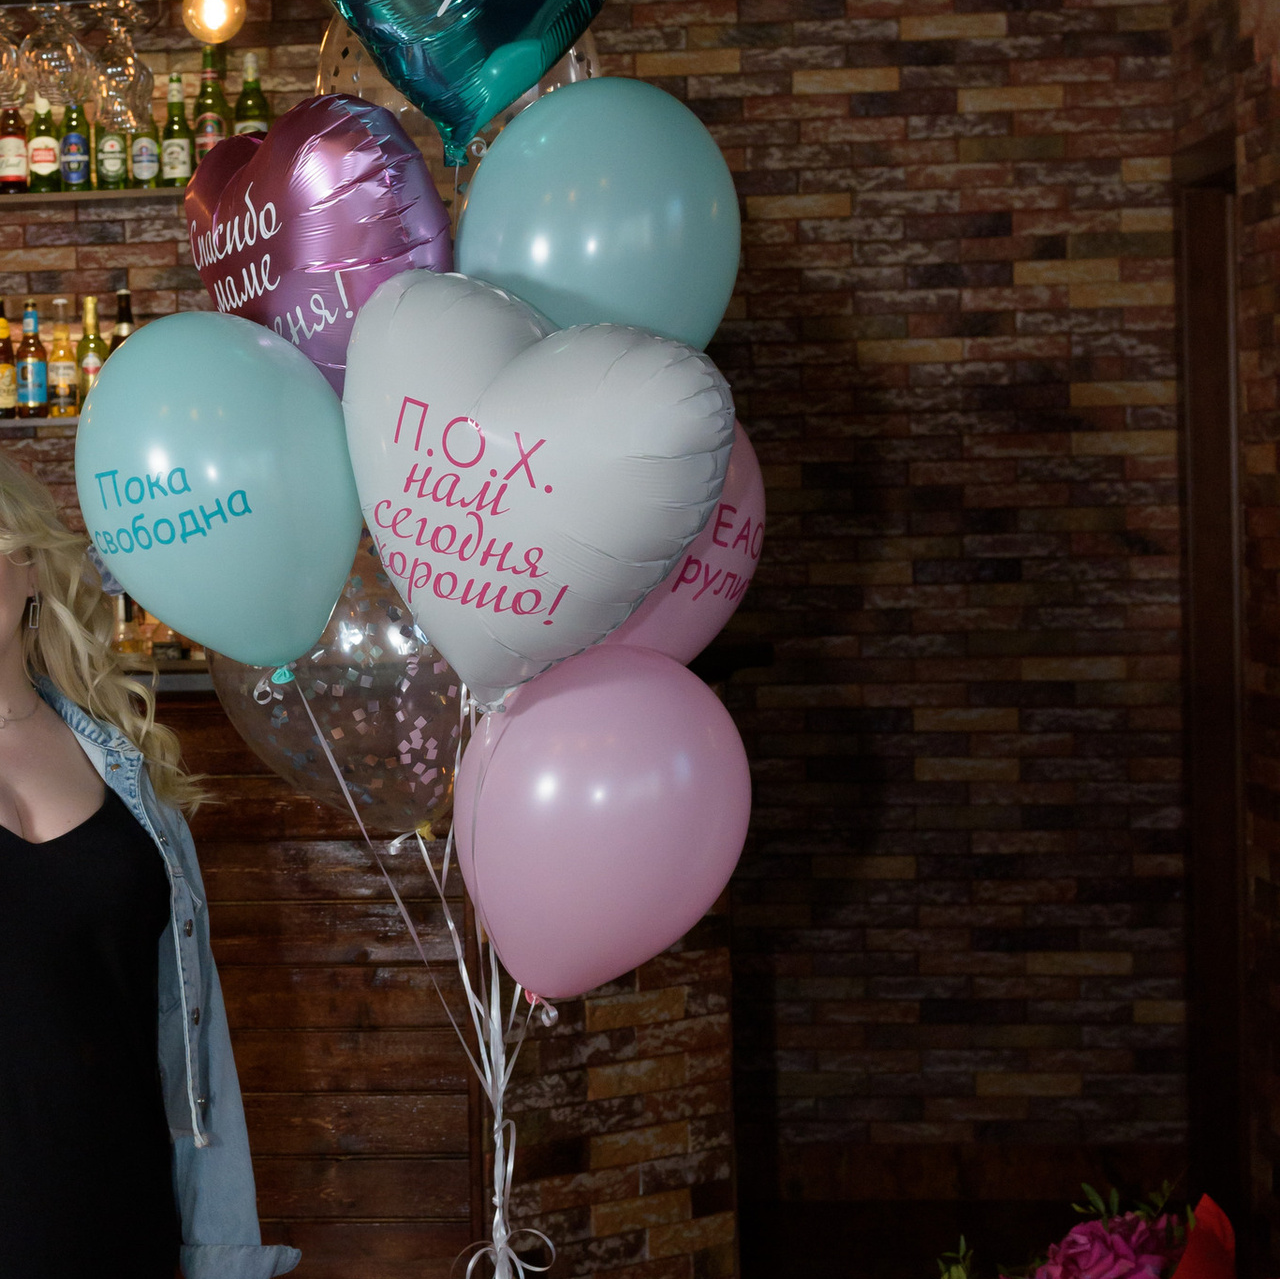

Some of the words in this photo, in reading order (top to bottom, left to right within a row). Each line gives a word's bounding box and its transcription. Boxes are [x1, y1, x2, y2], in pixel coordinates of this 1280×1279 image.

[190, 181, 282, 271] Спасибо
[214, 254, 281, 313] маме
[265, 271, 354, 345] еня!
[394, 396, 553, 494] П.О.Х.
[95, 467, 191, 510] Пока
[404, 463, 510, 516] нам
[94, 489, 252, 555] свободна
[374, 499, 549, 578] сегодня
[671, 554, 748, 603] рули
